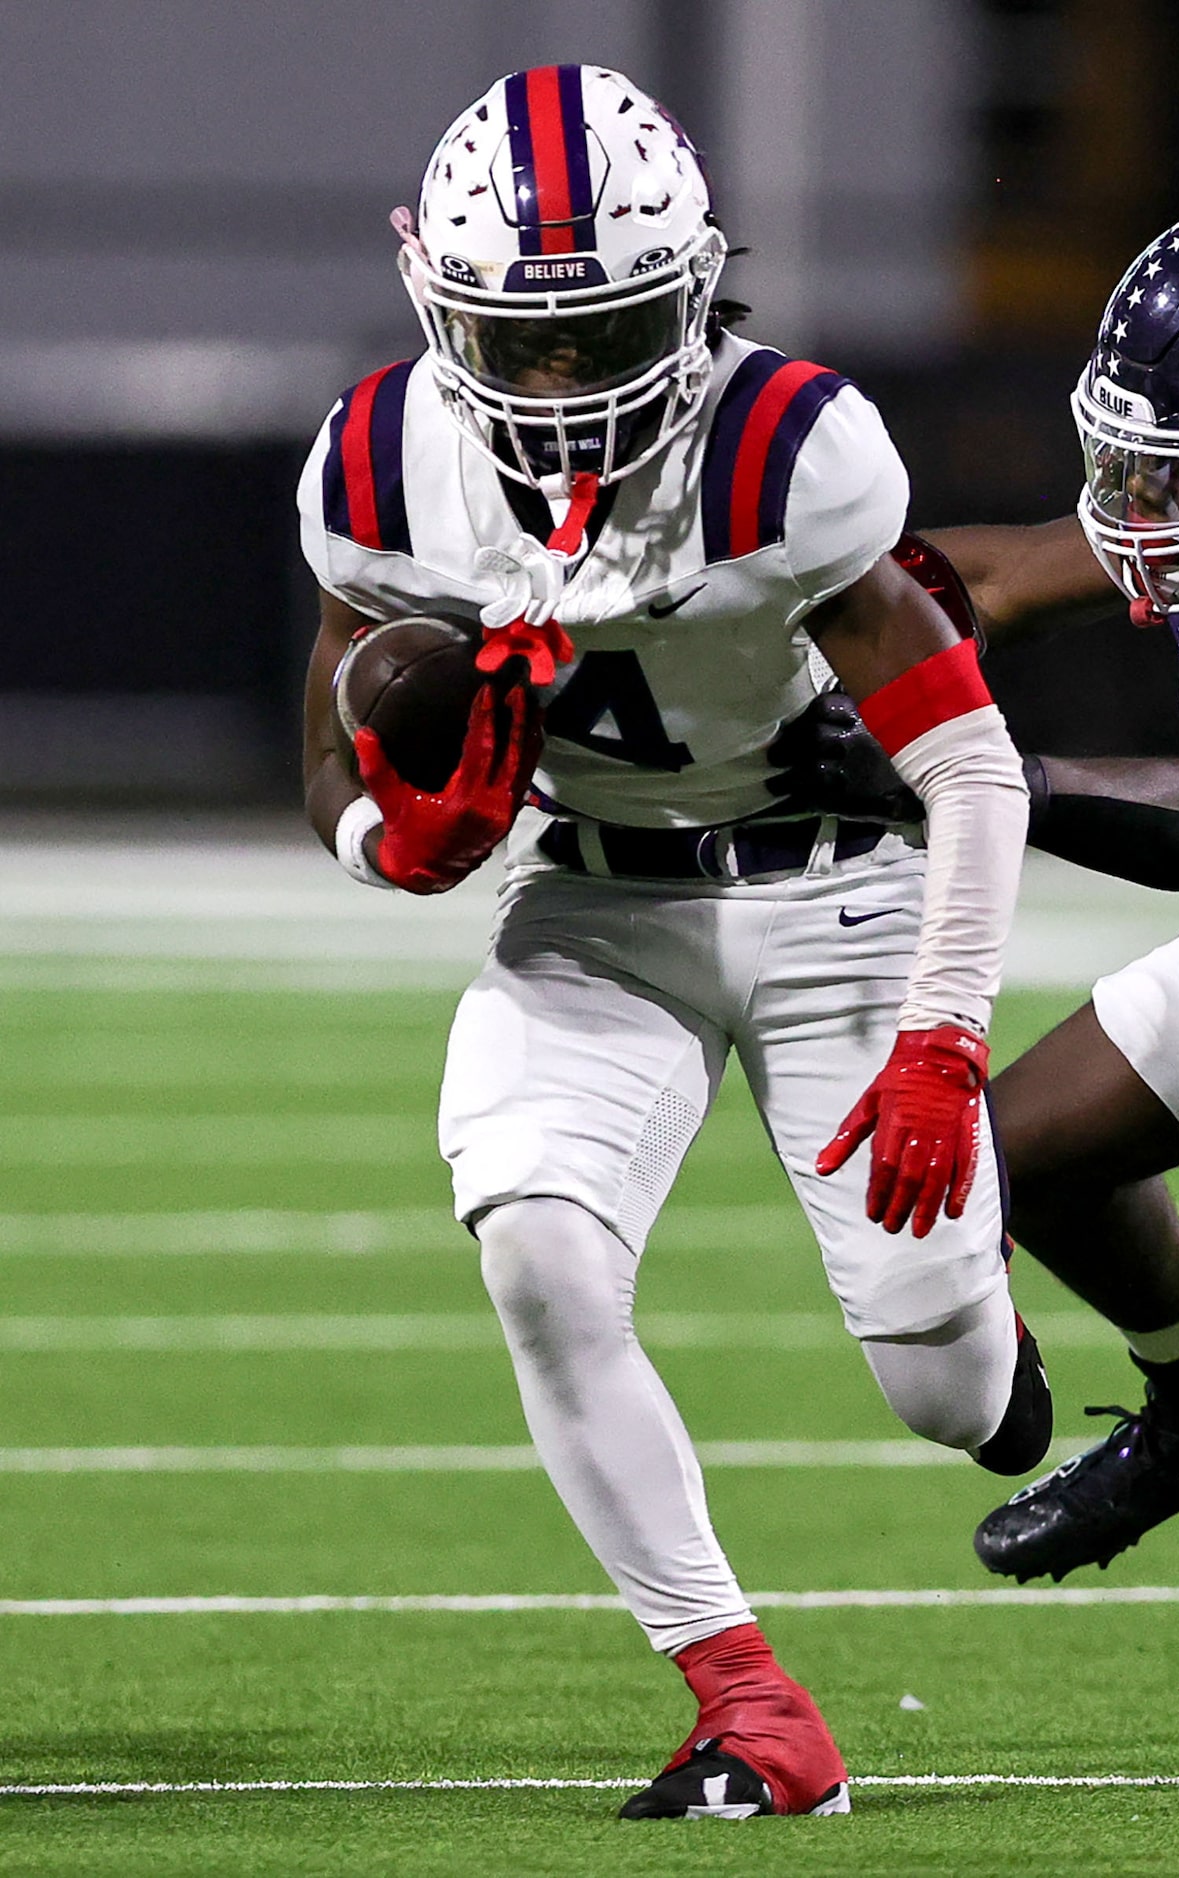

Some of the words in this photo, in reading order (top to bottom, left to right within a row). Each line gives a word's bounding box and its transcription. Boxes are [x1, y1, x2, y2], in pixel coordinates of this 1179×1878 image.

[524, 262, 586, 279] BELIEVE
[1100, 386, 1133, 417] BLUE
[544, 649, 695, 773] 4
